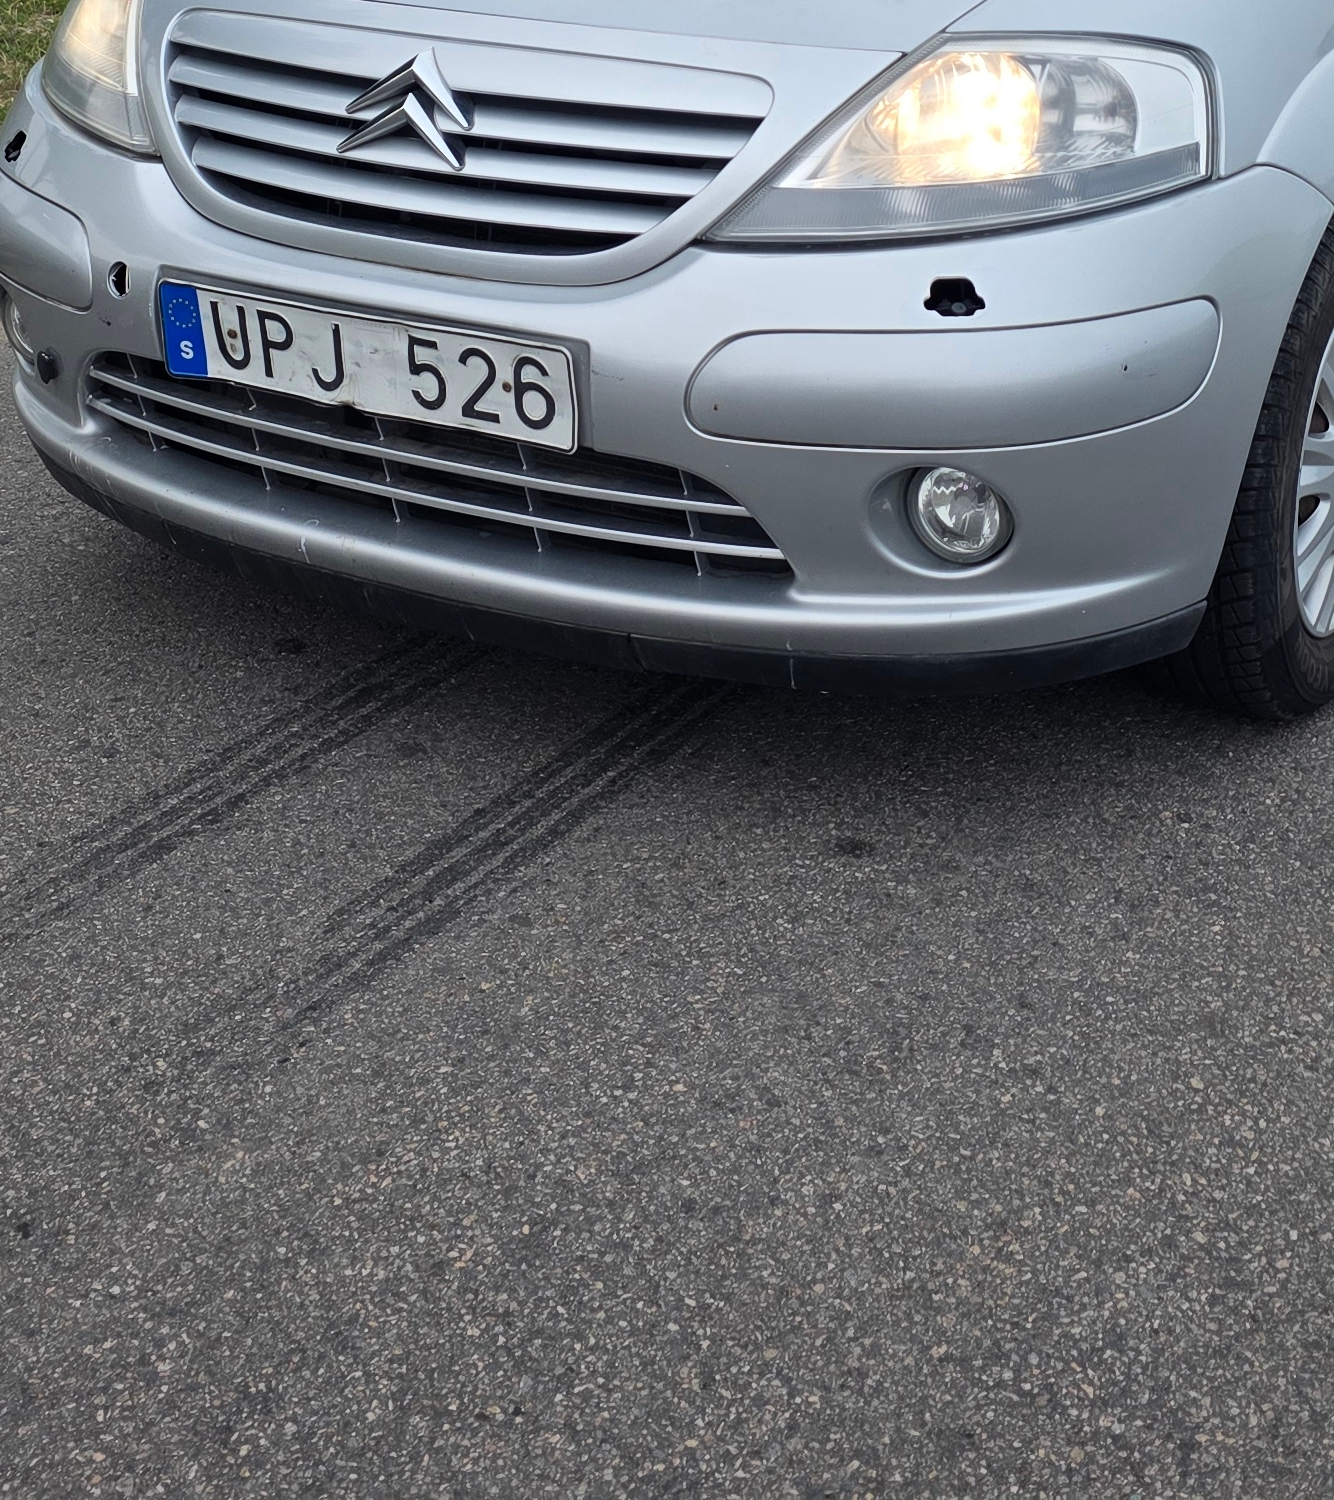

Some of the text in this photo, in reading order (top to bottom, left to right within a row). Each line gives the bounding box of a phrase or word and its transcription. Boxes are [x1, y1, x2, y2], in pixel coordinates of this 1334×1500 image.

[179, 340, 194, 360] S
[210, 300, 556, 430] UPJ 526
